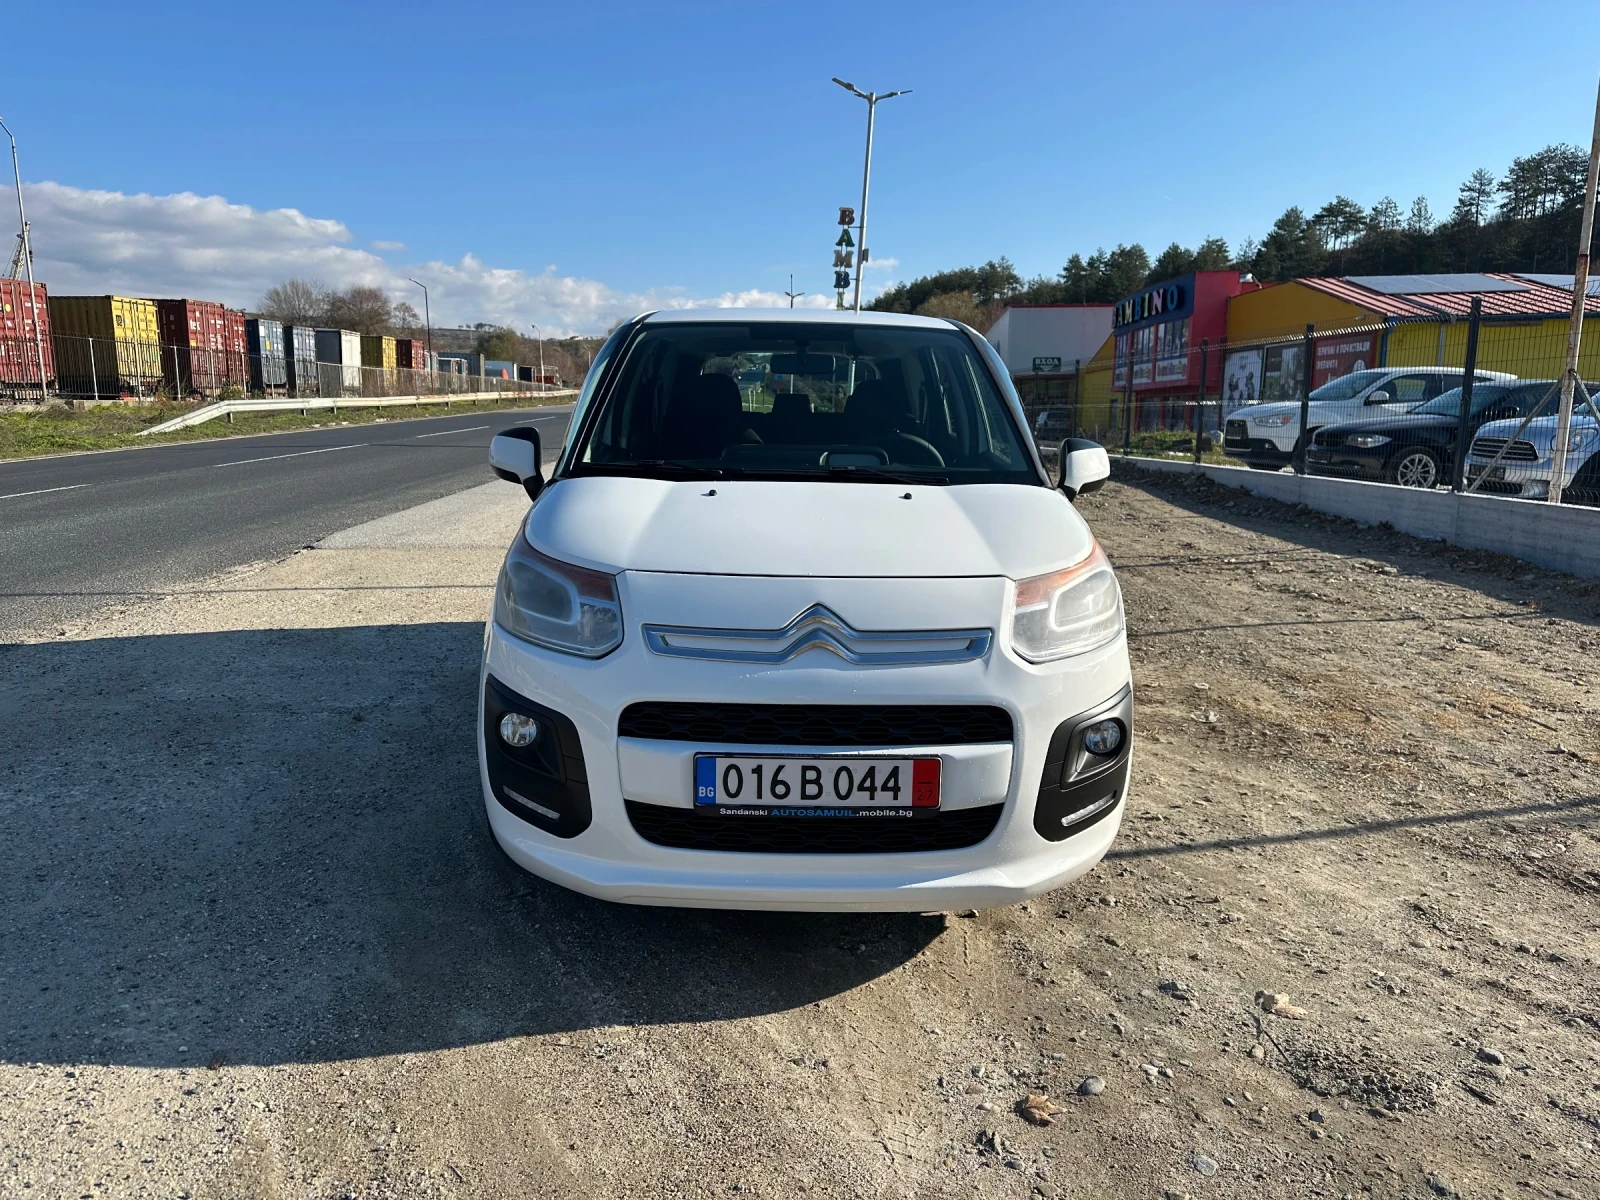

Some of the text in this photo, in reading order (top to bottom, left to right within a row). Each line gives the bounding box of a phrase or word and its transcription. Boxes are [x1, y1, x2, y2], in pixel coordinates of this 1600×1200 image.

[1112, 285, 1178, 329] BAMBINO
[699, 786, 714, 797] BG
[719, 808, 768, 816] Sandanski
